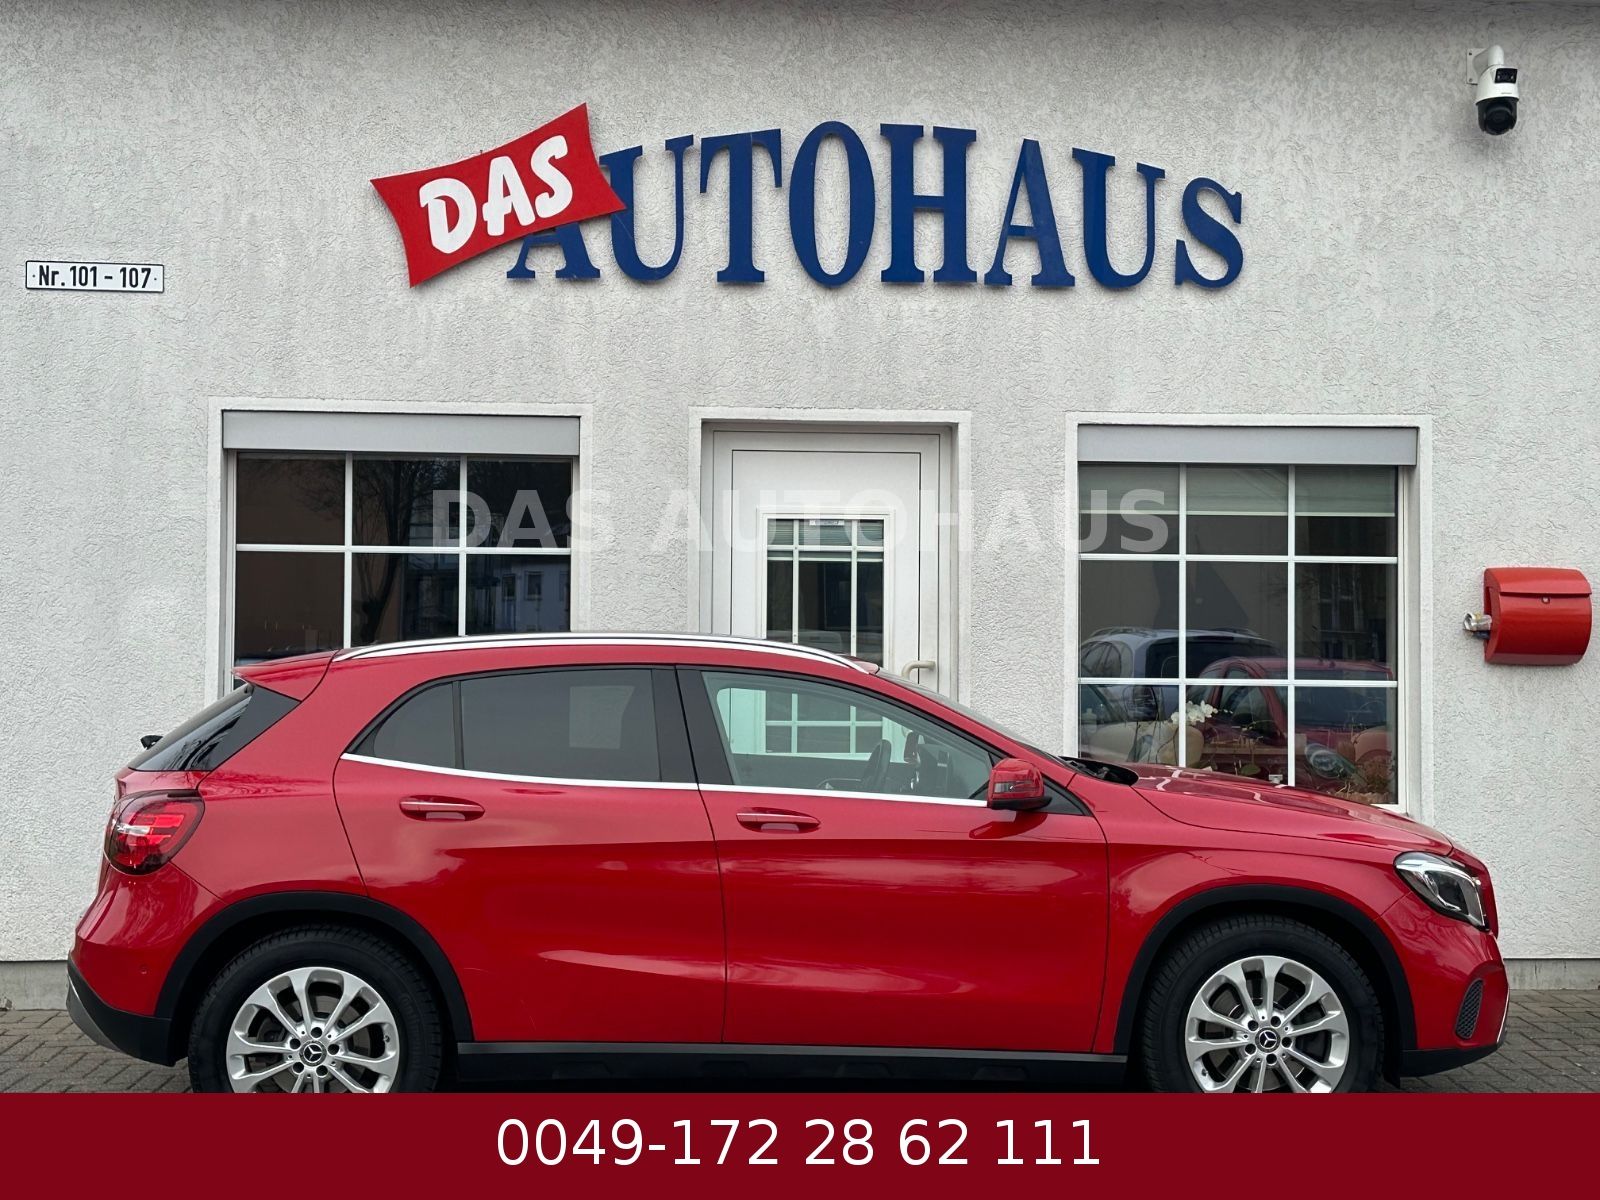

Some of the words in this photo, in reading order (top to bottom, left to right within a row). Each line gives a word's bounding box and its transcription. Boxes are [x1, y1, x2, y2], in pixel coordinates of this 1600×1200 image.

[419, 134, 574, 254] DAS
[38, 264, 66, 287] Nr.
[69, 265, 98, 288] 101
[119, 266, 152, 289] 107
